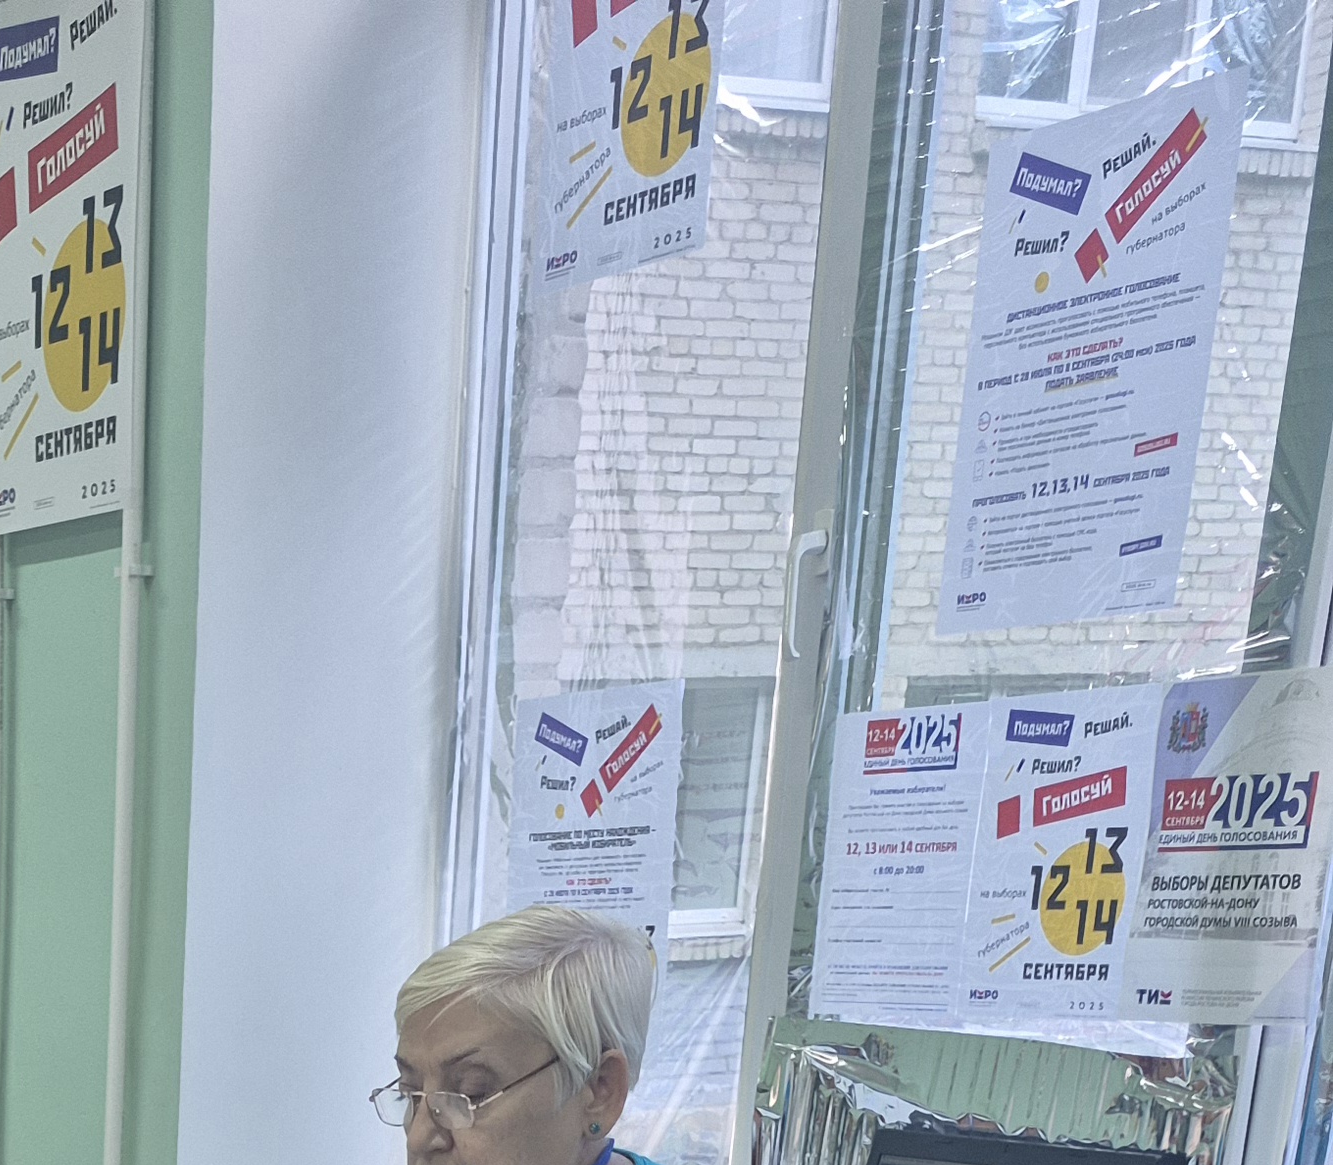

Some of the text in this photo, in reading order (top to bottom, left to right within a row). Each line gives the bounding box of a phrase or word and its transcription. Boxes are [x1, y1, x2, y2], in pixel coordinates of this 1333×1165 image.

[668, 0, 710, 60] 13
[610, 54, 652, 130] 12
[556, 107, 607, 133] на выборах
[659, 83, 704, 160] 14
[554, 147, 611, 214] губернатора
[603, 173, 697, 226] СЕНТЯБРЯ
[1151, 181, 1207, 225] на выборах
[83, 184, 123, 274] 13
[653, 227, 692, 249] 2025
[1125, 221, 1186, 255] губернатора
[31, 265, 71, 349] 12
[0, 319, 30, 340] выборах
[79, 307, 121, 392] 14
[35, 415, 117, 463] СЕНТЯБРЯ
[81, 479, 116, 499] 2025
[868, 714, 957, 755] 12-14 2025
[1167, 772, 1307, 828] 12-14 2025
[1159, 829, 1298, 845] ЕДИНЫЙ ДЕНЬ ГОЛОСОВАНИЯ
[1165, 815, 1206, 827] СЕНТЯБРЯ
[865, 842, 876, 854] 13
[900, 840, 913, 853] 14
[915, 841, 957, 853] СЕНТЯБРЯ
[1085, 826, 1128, 874] 13
[980, 888, 1027, 899] на выборах
[1031, 865, 1070, 910] 12
[1151, 873, 1302, 893] ВЫБОРЫ ДЕПУТАТОВ
[1076, 899, 1118, 945] 14
[1144, 914, 1298, 929] ГОРОДСКОЙ ДУМЫ VIII СОЗЫВА
[1147, 896, 1260, 910] РОСТОВСКОЙ-НА-ДОНУ
[977, 921, 1030, 958] губернатора
[1022, 963, 1109, 981] СЕНТЯБРЯ
[1069, 1001, 1104, 1010] 2025
